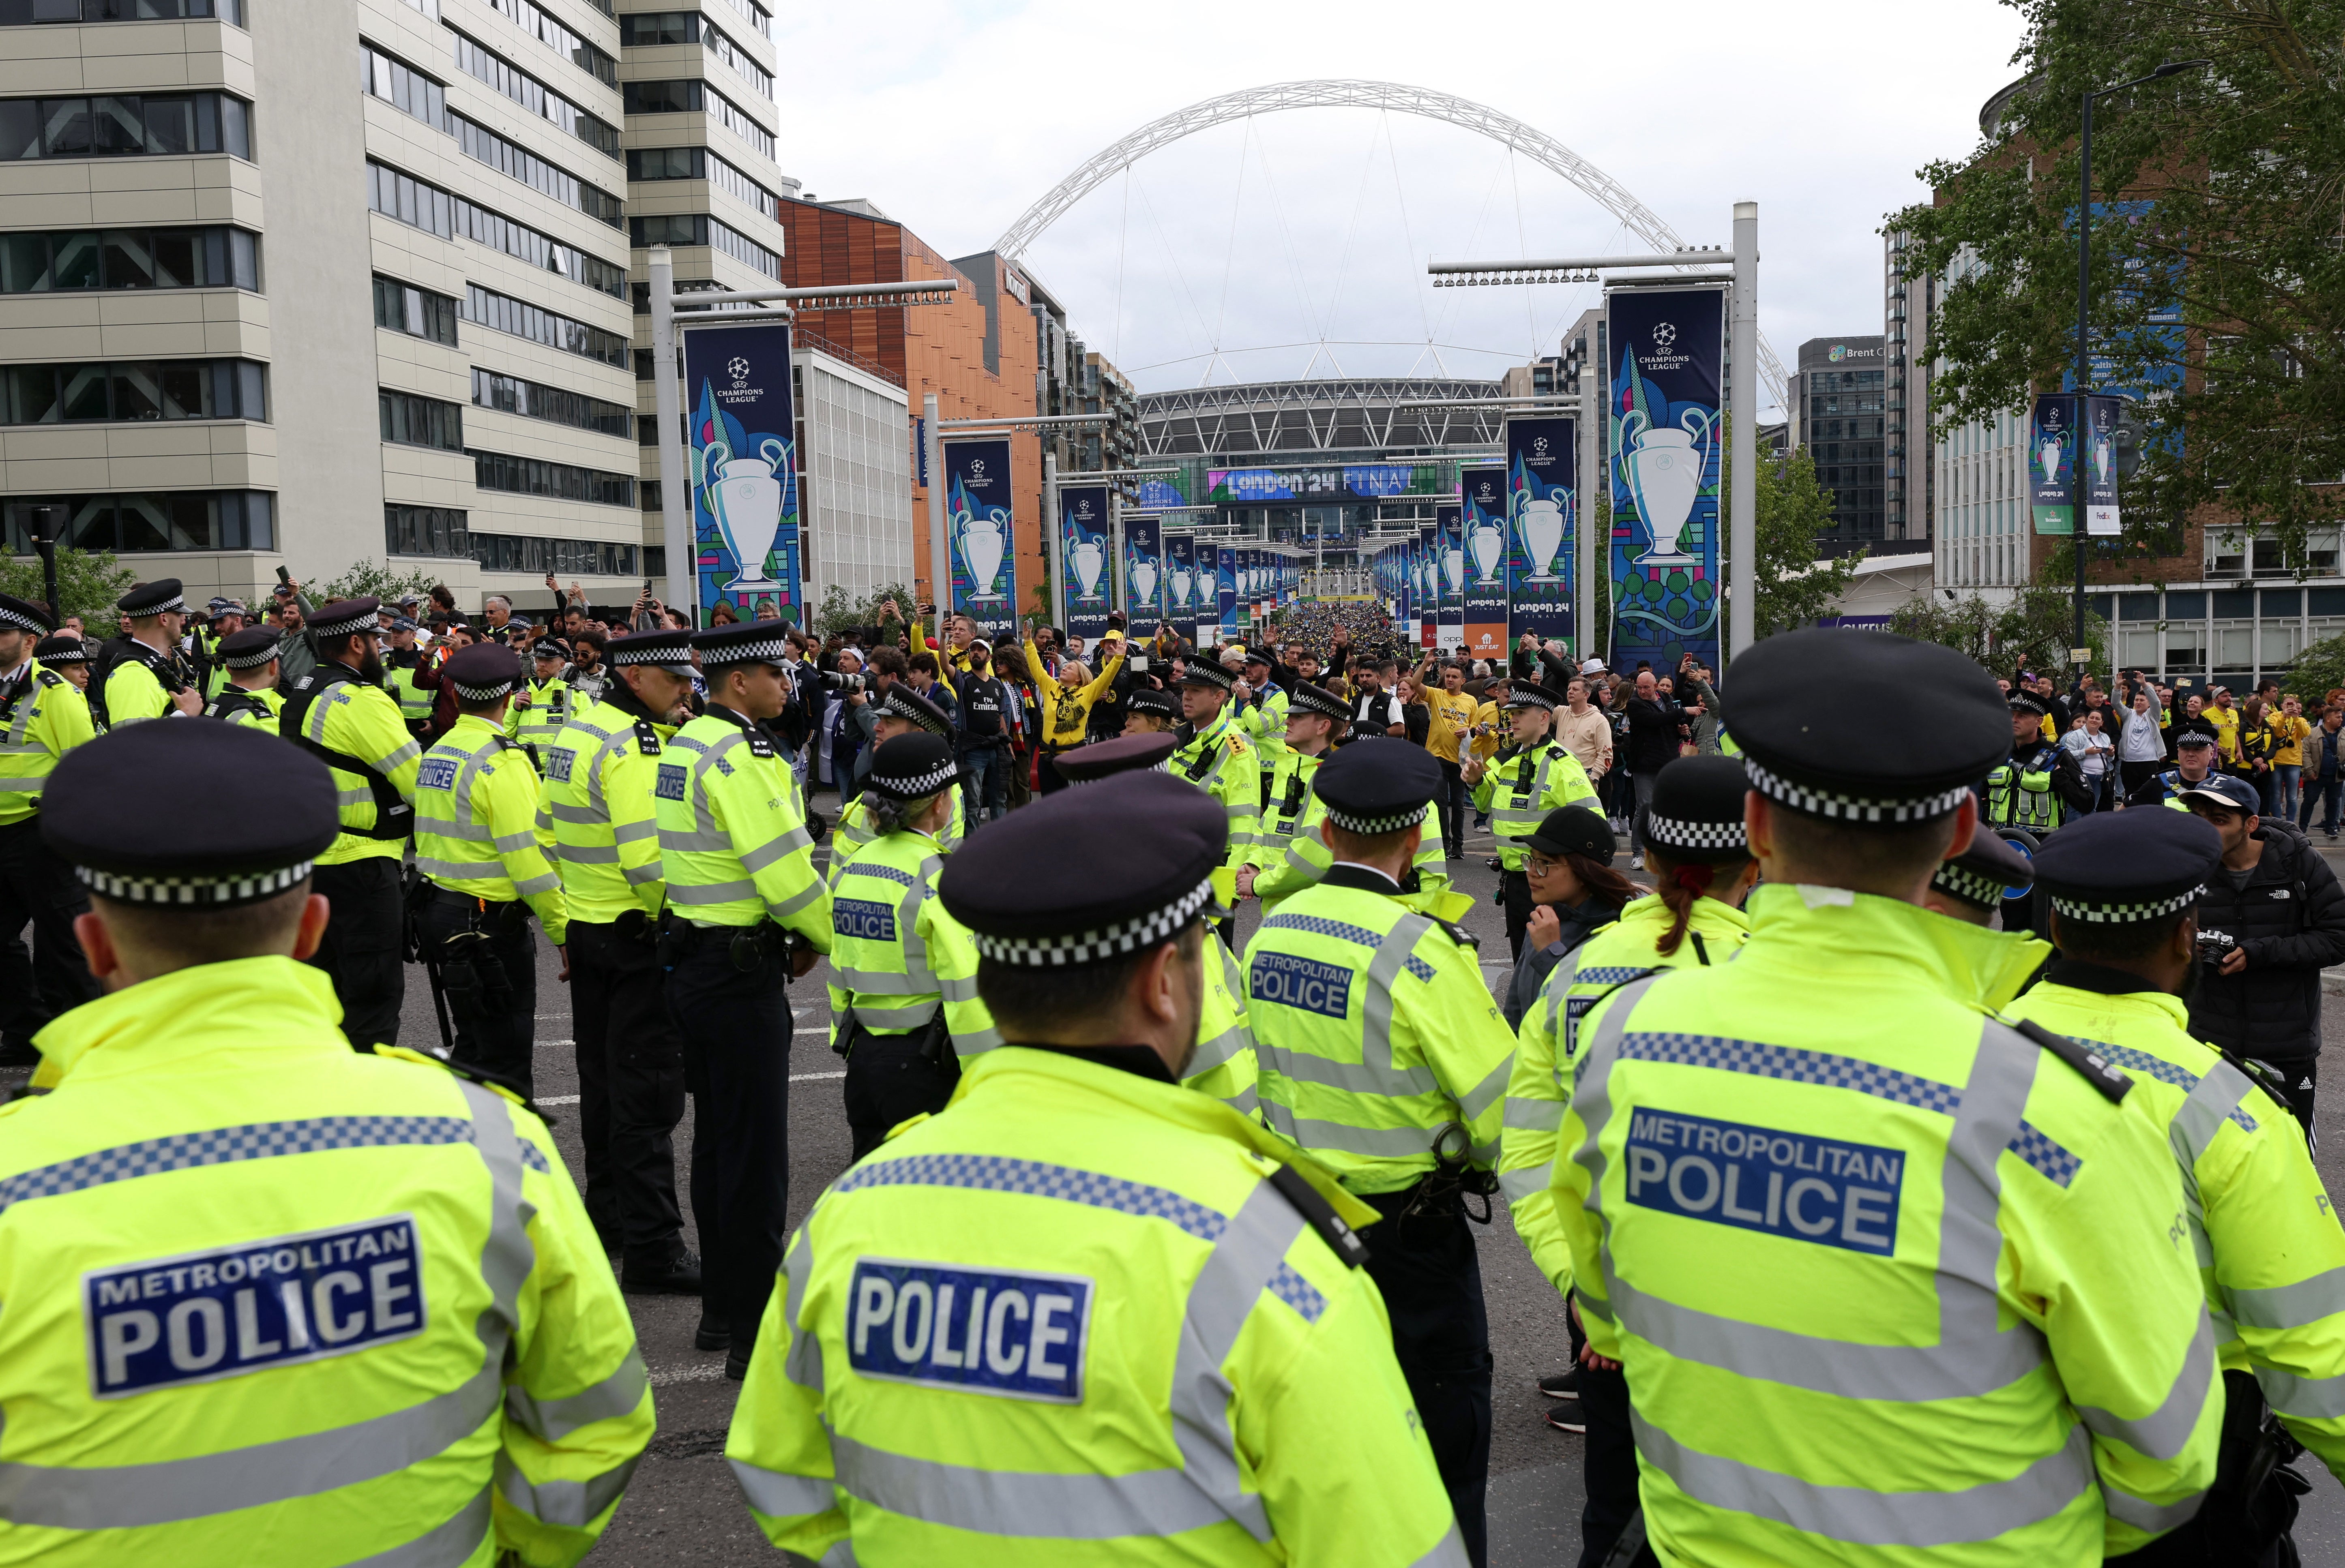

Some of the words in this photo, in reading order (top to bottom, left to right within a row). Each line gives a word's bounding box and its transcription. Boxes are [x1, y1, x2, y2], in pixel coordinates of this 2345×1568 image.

[1639, 355, 1689, 363] CHAMPIONS
[1847, 348, 1874, 357] Brent
[717, 388, 763, 396] CHAMPIONS
[1308, 473, 1335, 492] 24
[1343, 471, 1416, 491] FINAL
[2096, 512, 2110, 520] FedEx
[1555, 603, 1569, 612] 24
[999, 620, 1012, 630] 24
[1440, 708, 1467, 716] YELLOW
[422, 760, 456, 770] ETROPOLITAN
[659, 765, 686, 779] ETROPOLITAN
[658, 776, 685, 799] OLICE
[1568, 779, 1586, 788] POLICE
[833, 911, 895, 938] POLICE
[1253, 953, 1351, 985] METROPOLITAN
[1251, 968, 1346, 1014] POLICE
[1631, 1113, 1900, 1187] METROPOLITAN
[1628, 1145, 1894, 1249] POLICE
[98, 1225, 410, 1308] METROPOLITAN
[100, 1257, 416, 1386] POLICE
[853, 1276, 1074, 1381] POLICE
